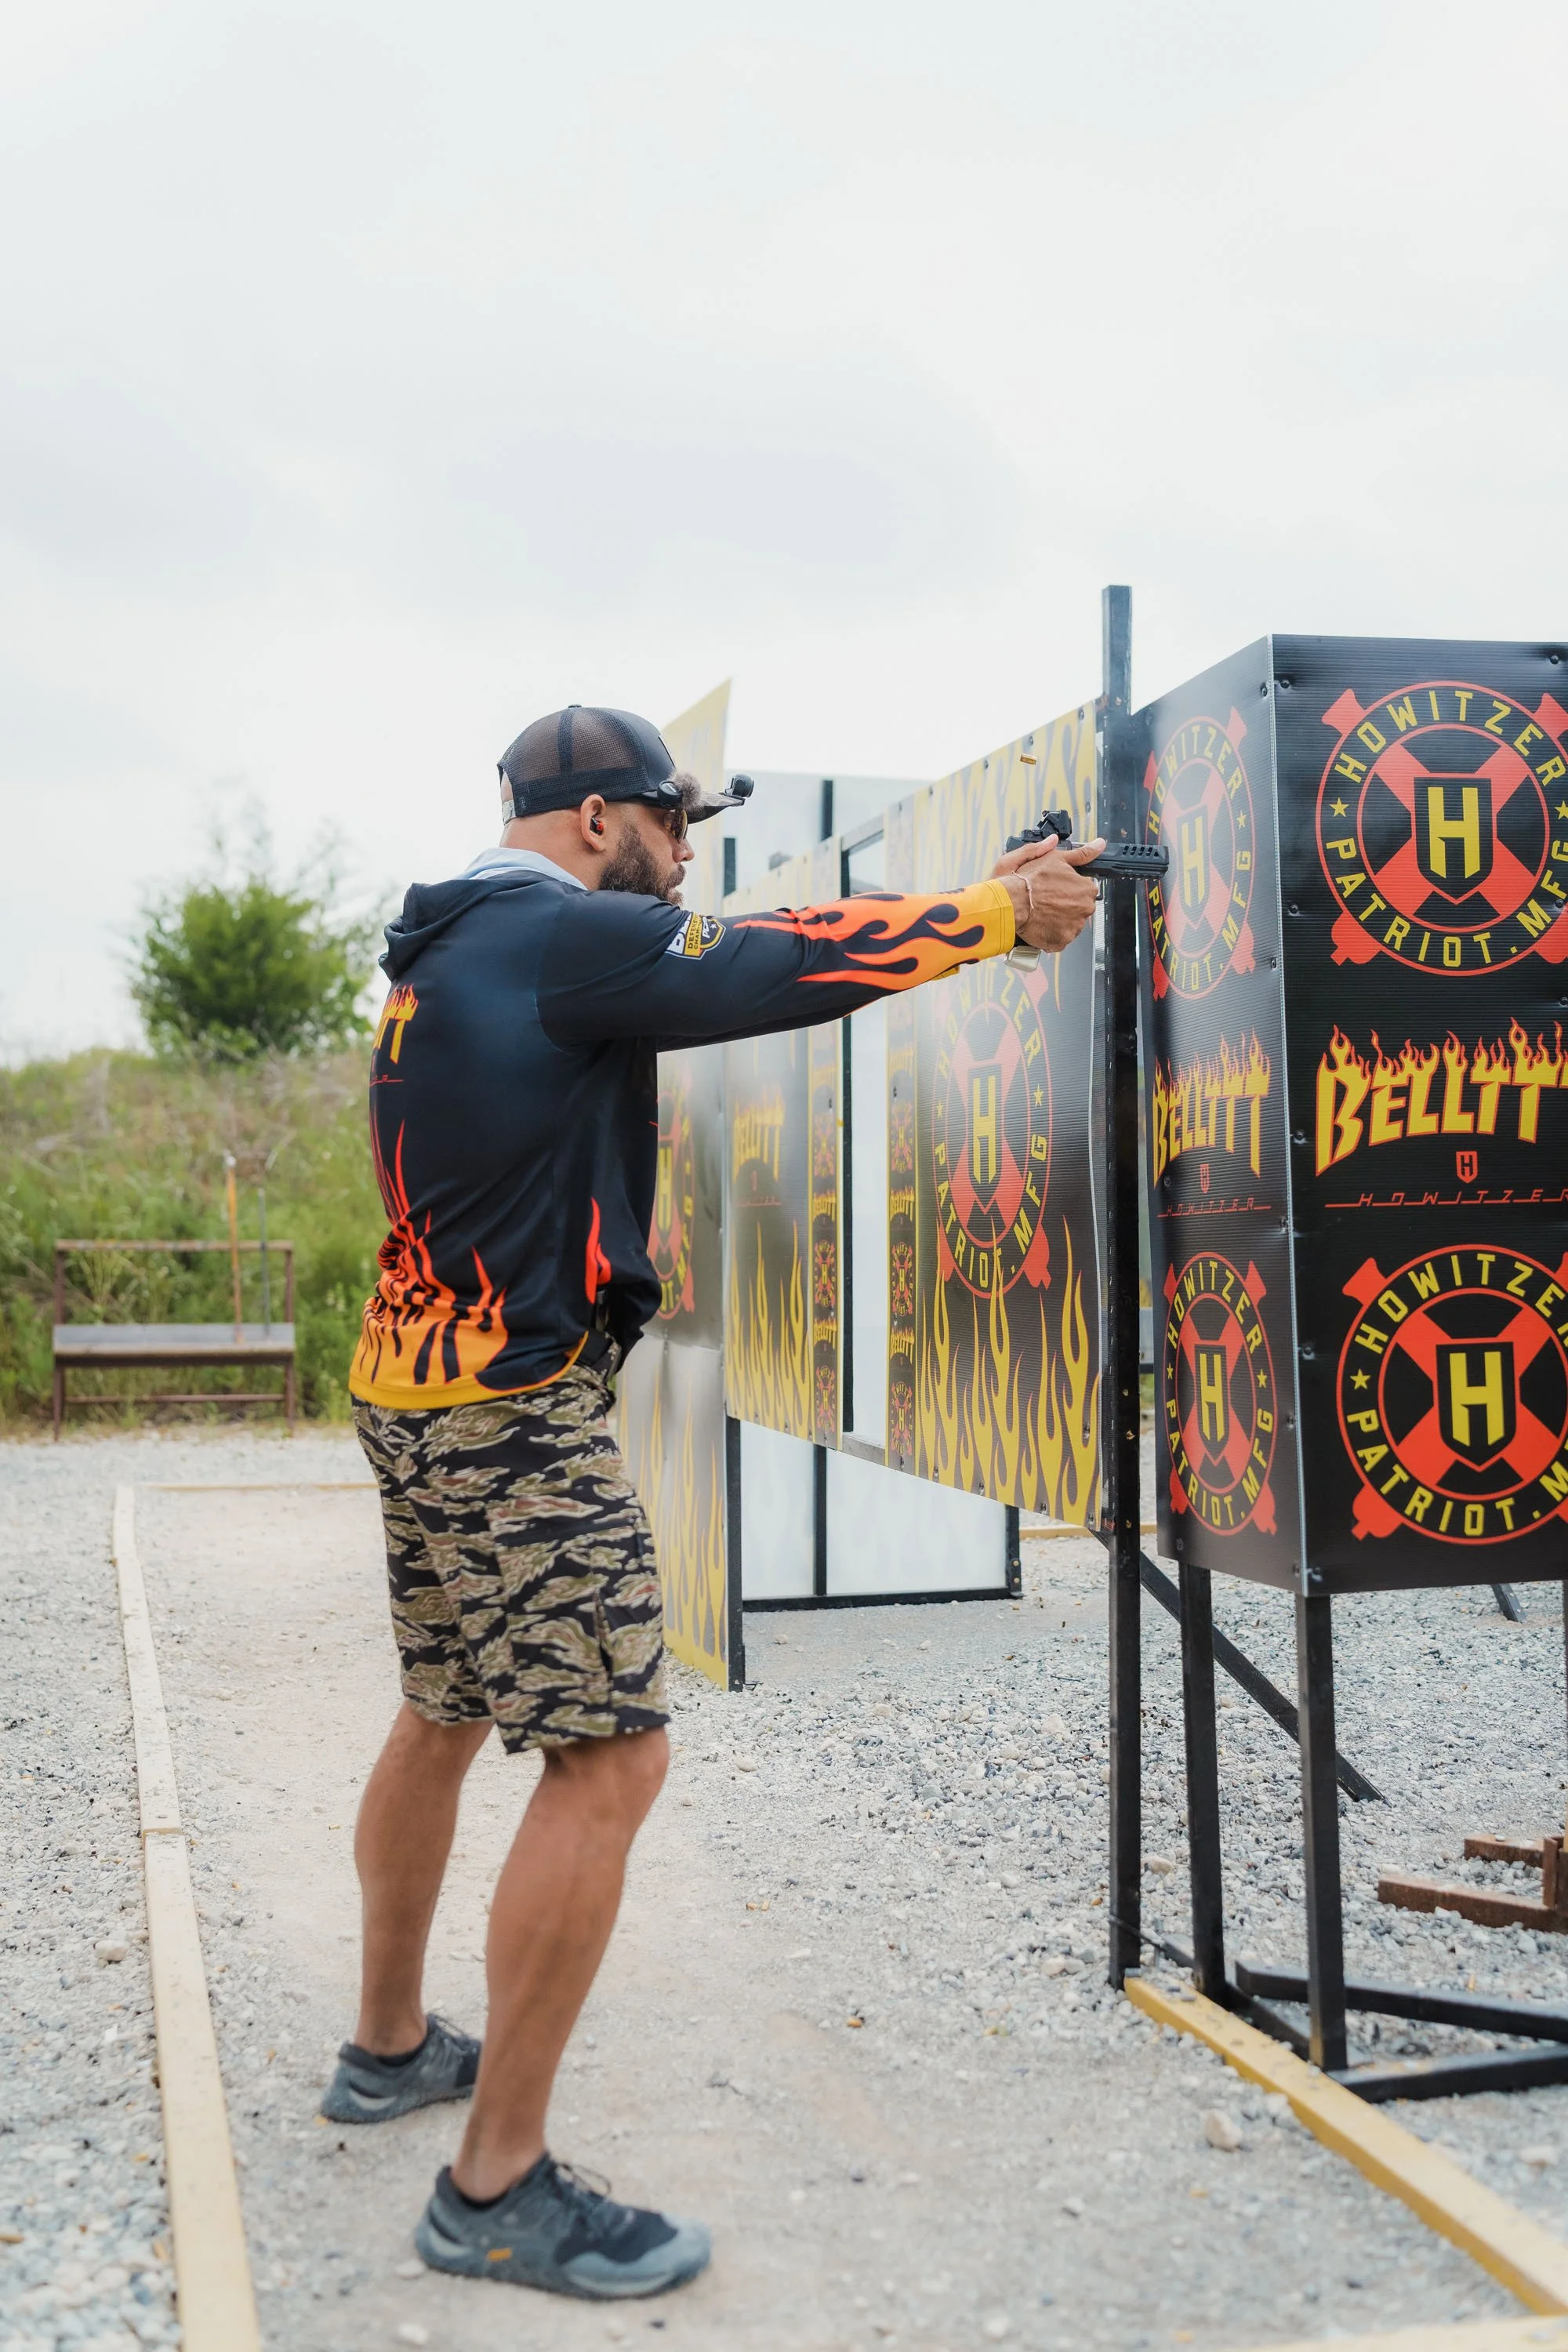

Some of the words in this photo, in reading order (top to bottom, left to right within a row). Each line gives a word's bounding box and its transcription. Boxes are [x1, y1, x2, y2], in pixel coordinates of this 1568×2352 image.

[1149, 725, 1243, 834] HOWITZER
[1334, 691, 1566, 786] HOWITZER
[1181, 816, 1205, 906] H
[1428, 787, 1480, 878] H
[973, 1075, 996, 1184] H
[1315, 1017, 1568, 1177] BELLTT
[1167, 1261, 1262, 1354] HOWITZER
[1355, 1253, 1568, 1353] HOWITZE
[1200, 1353, 1225, 1443] H
[1450, 1352, 1505, 1446] H
